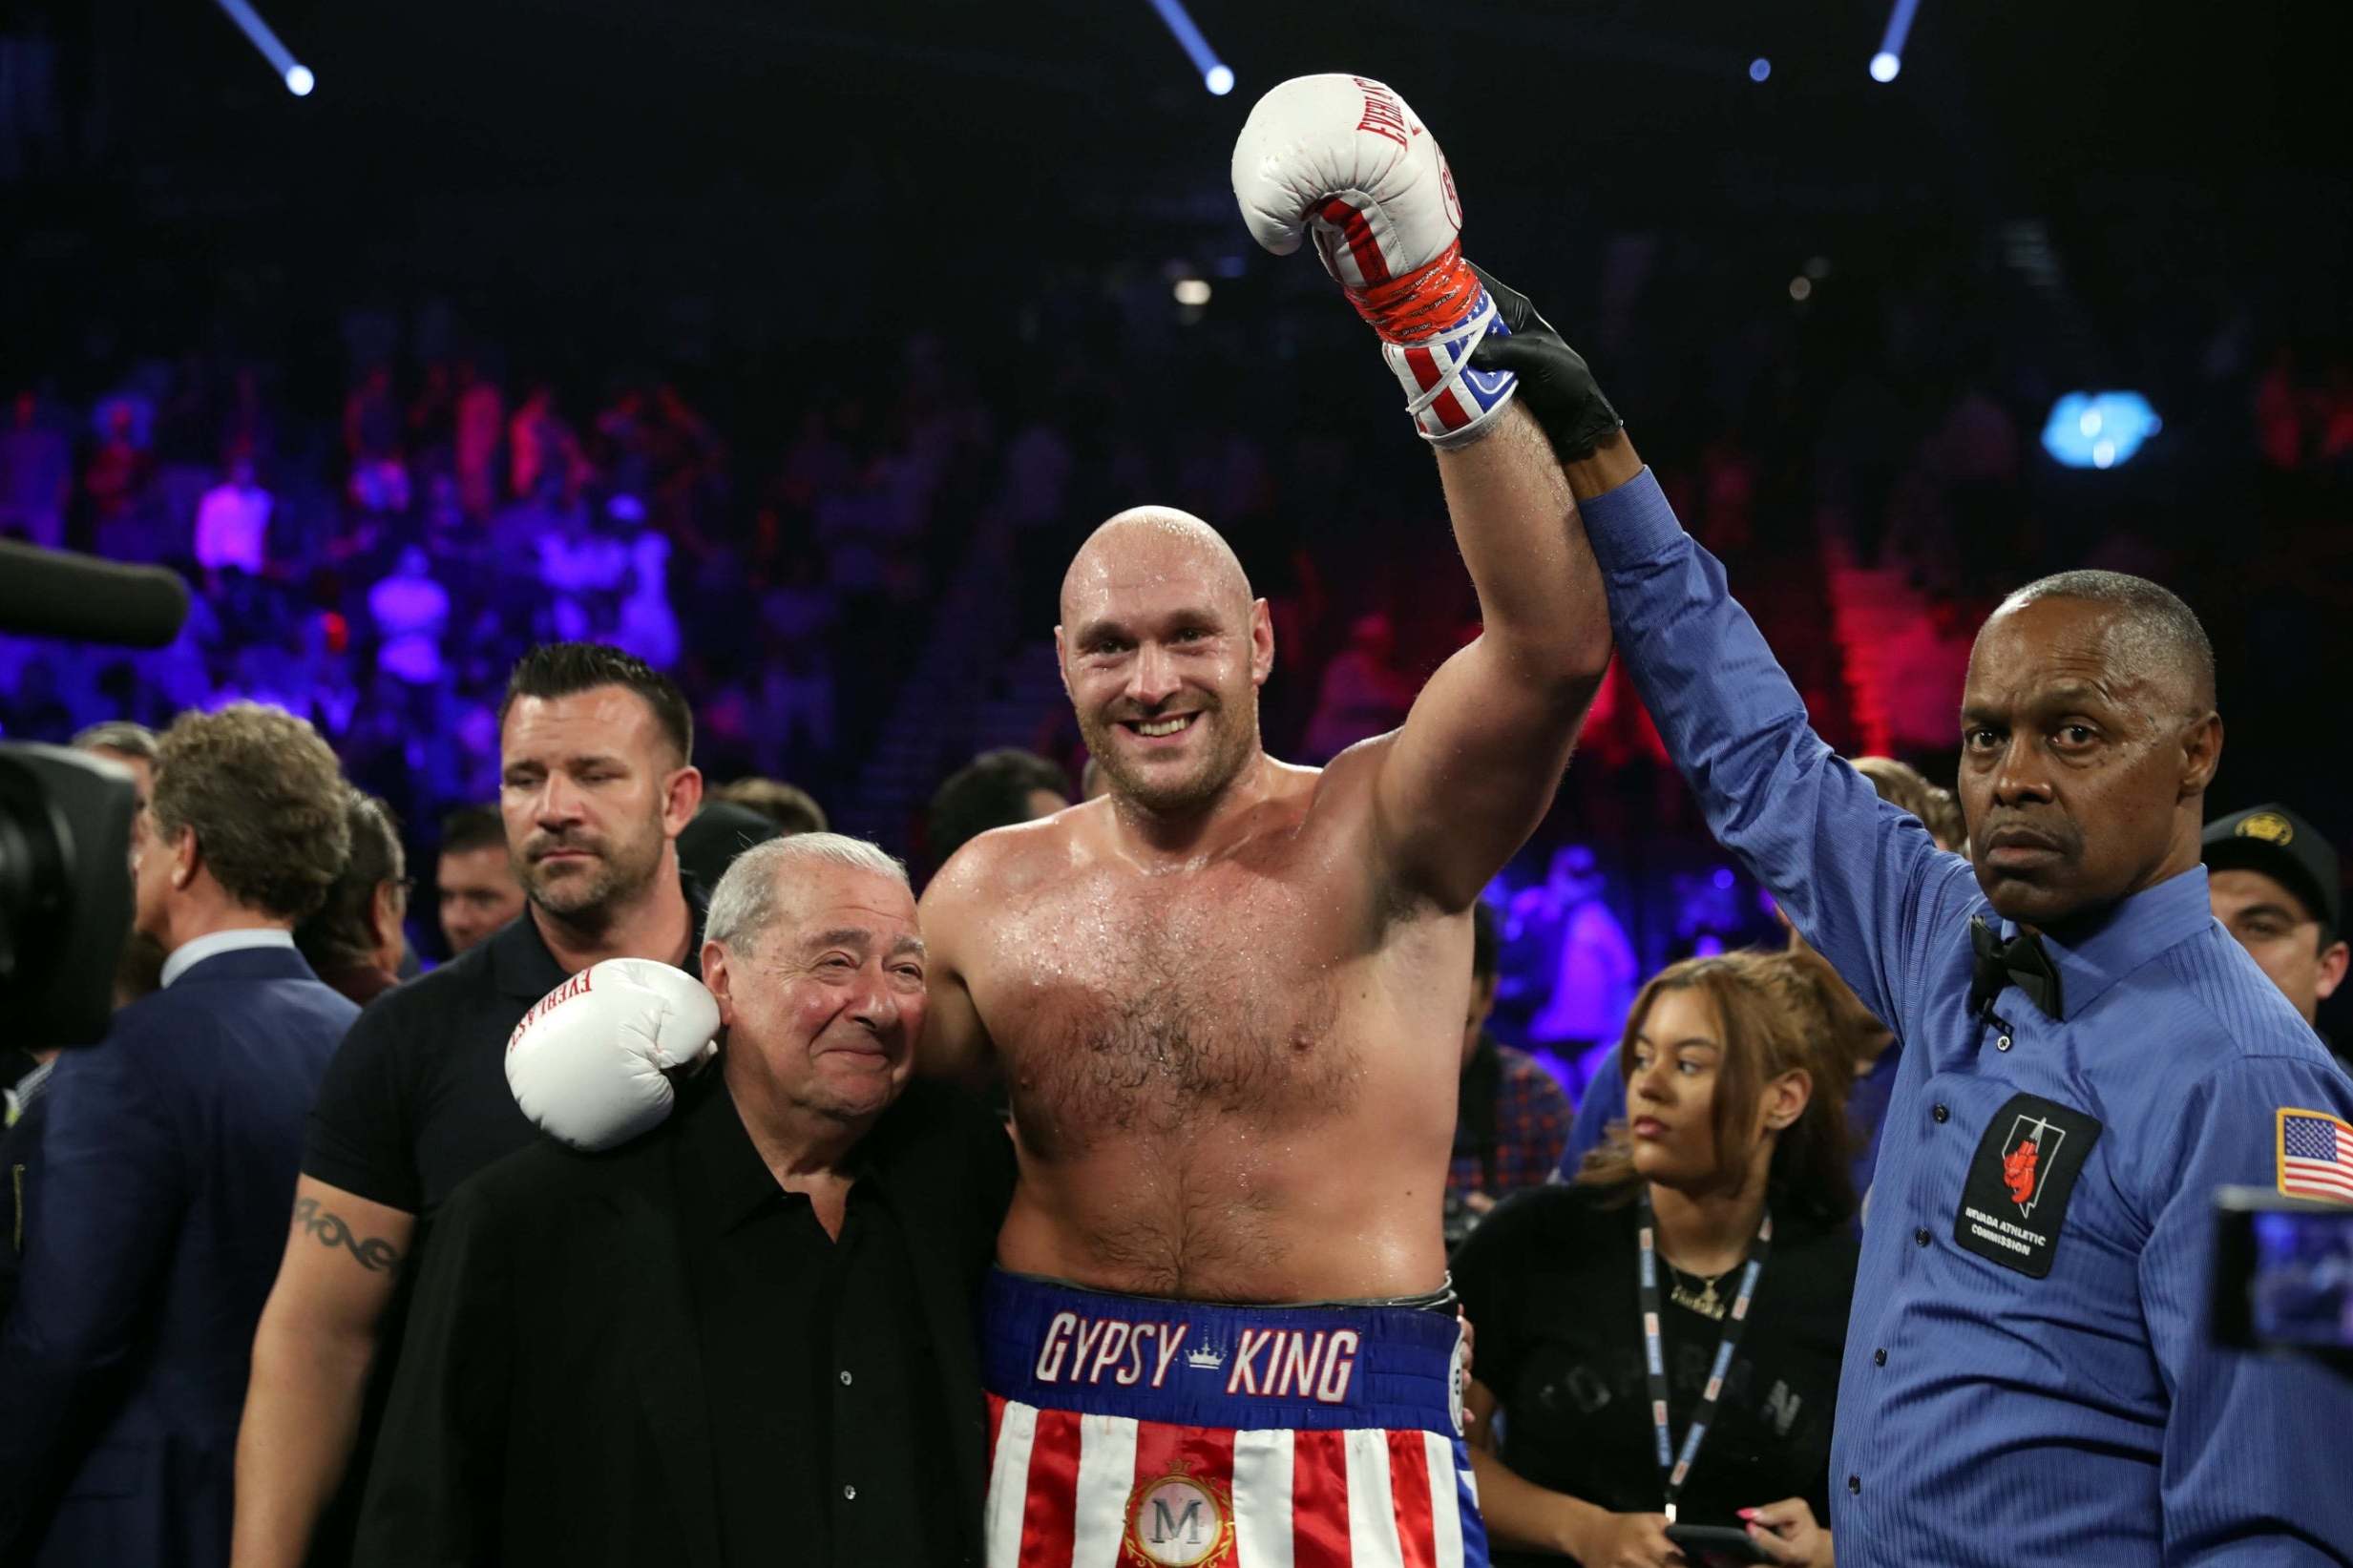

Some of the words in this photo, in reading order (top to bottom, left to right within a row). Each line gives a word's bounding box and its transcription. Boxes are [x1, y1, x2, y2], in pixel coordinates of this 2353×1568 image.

[1965, 1206, 1999, 1229] NEVADA
[1999, 1221, 2047, 1246] ATHLETIC
[1971, 1223, 2031, 1256] COMMISSION
[1036, 1311, 1189, 1389] GYPSY
[1228, 1328, 1359, 1403] KING
[1149, 1497, 1203, 1544] M
